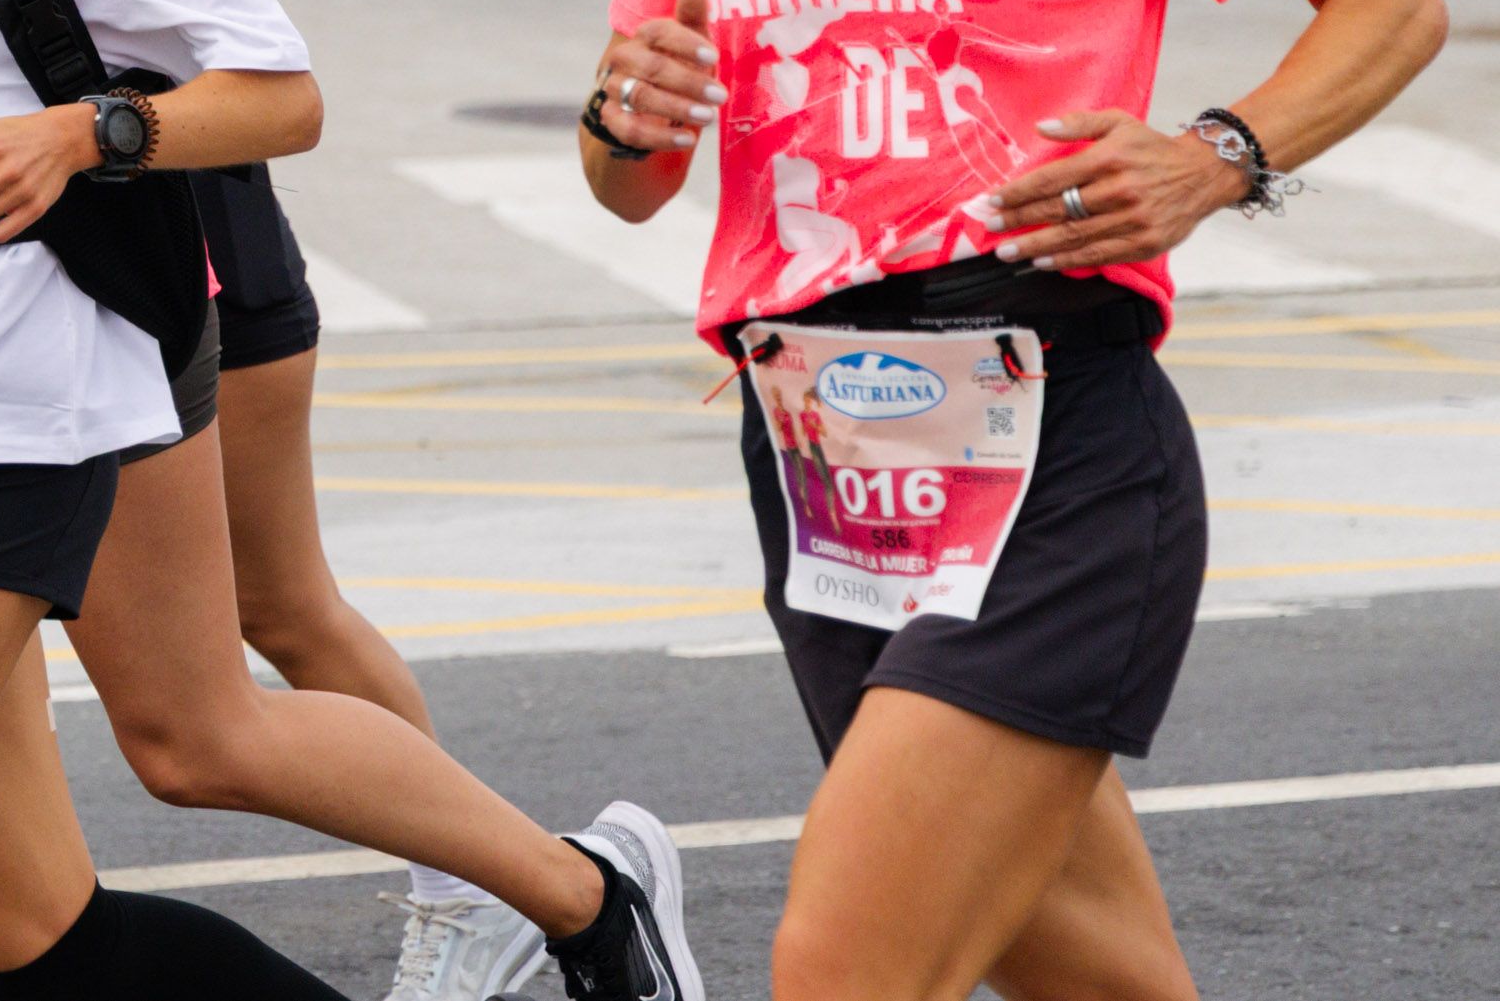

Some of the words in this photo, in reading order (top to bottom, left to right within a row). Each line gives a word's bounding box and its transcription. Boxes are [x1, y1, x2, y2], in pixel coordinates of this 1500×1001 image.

[838, 39, 930, 159] DE
[826, 376, 935, 403] ASTURIANA
[836, 468, 947, 518] 016
[872, 529, 912, 549] 586
[880, 555, 929, 573] MUJER
[815, 574, 879, 607] OYSHO
